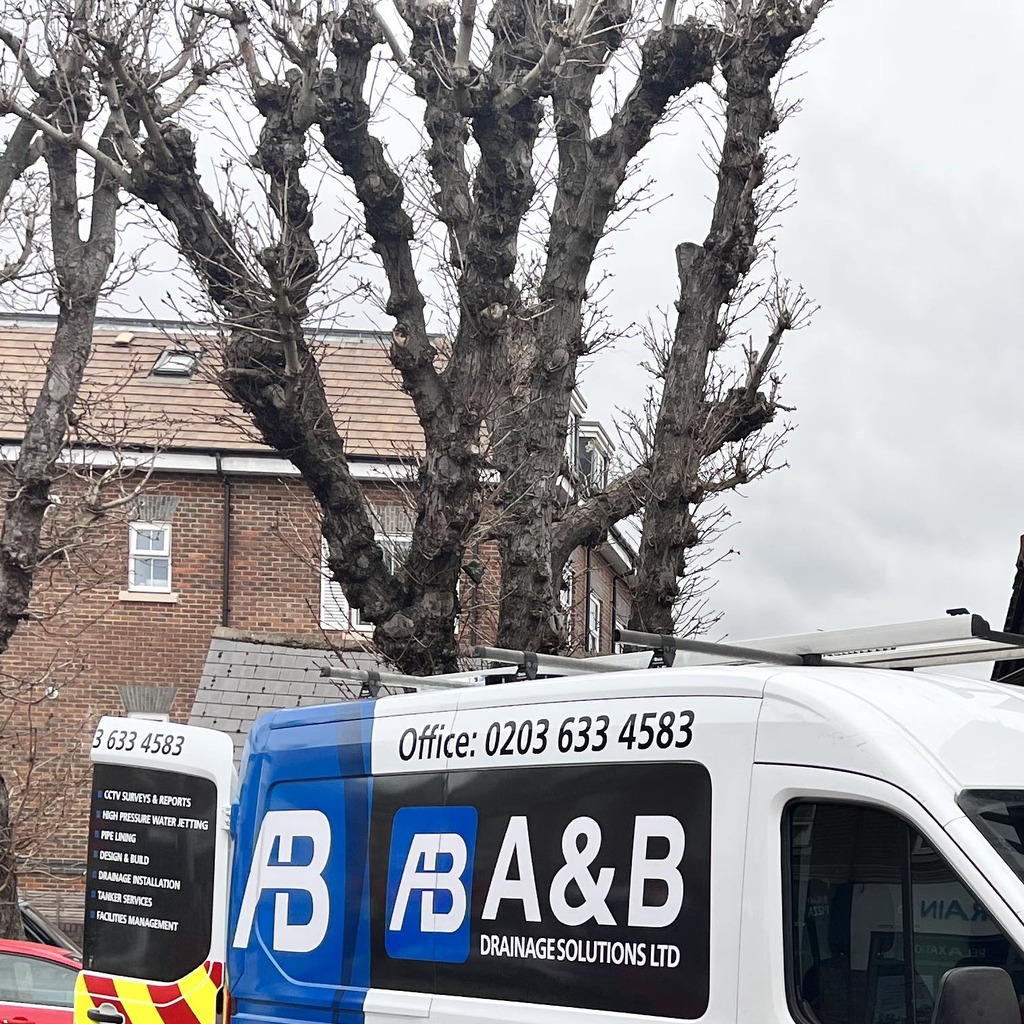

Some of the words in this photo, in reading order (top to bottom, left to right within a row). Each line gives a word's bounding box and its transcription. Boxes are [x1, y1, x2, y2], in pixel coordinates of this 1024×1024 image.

[107, 730, 137, 751] 633
[141, 733, 185, 756] 4583
[399, 724, 477, 761] Office:
[485, 717, 549, 756] 0203
[557, 714, 610, 753] 633
[618, 709, 695, 750] 4583
[103, 790, 121, 801] CCTV
[121, 791, 151, 804] SURVEYS
[152, 794, 158, 804] &
[159, 796, 192, 808] REPORTS
[102, 810, 119, 821] HIGH
[119, 811, 151, 824] PRESSURE
[152, 815, 176, 827] WATER
[177, 818, 209, 831] JETTING
[101, 830, 114, 841] PIPE
[115, 831, 137, 844] LINING
[99, 850, 123, 863] DESIGN
[123, 853, 129, 863] &
[130, 853, 150, 866] BUILD
[98, 870, 132, 884] DRAINAGE
[132, 875, 181, 890] INSTALLATION
[97, 890, 122, 903] TANKER
[122, 894, 153, 908] SERVICES
[96, 910, 127, 925] FACILITIES
[128, 915, 179, 931] MANAGEMENT
[649, 943, 681, 968] LTD
